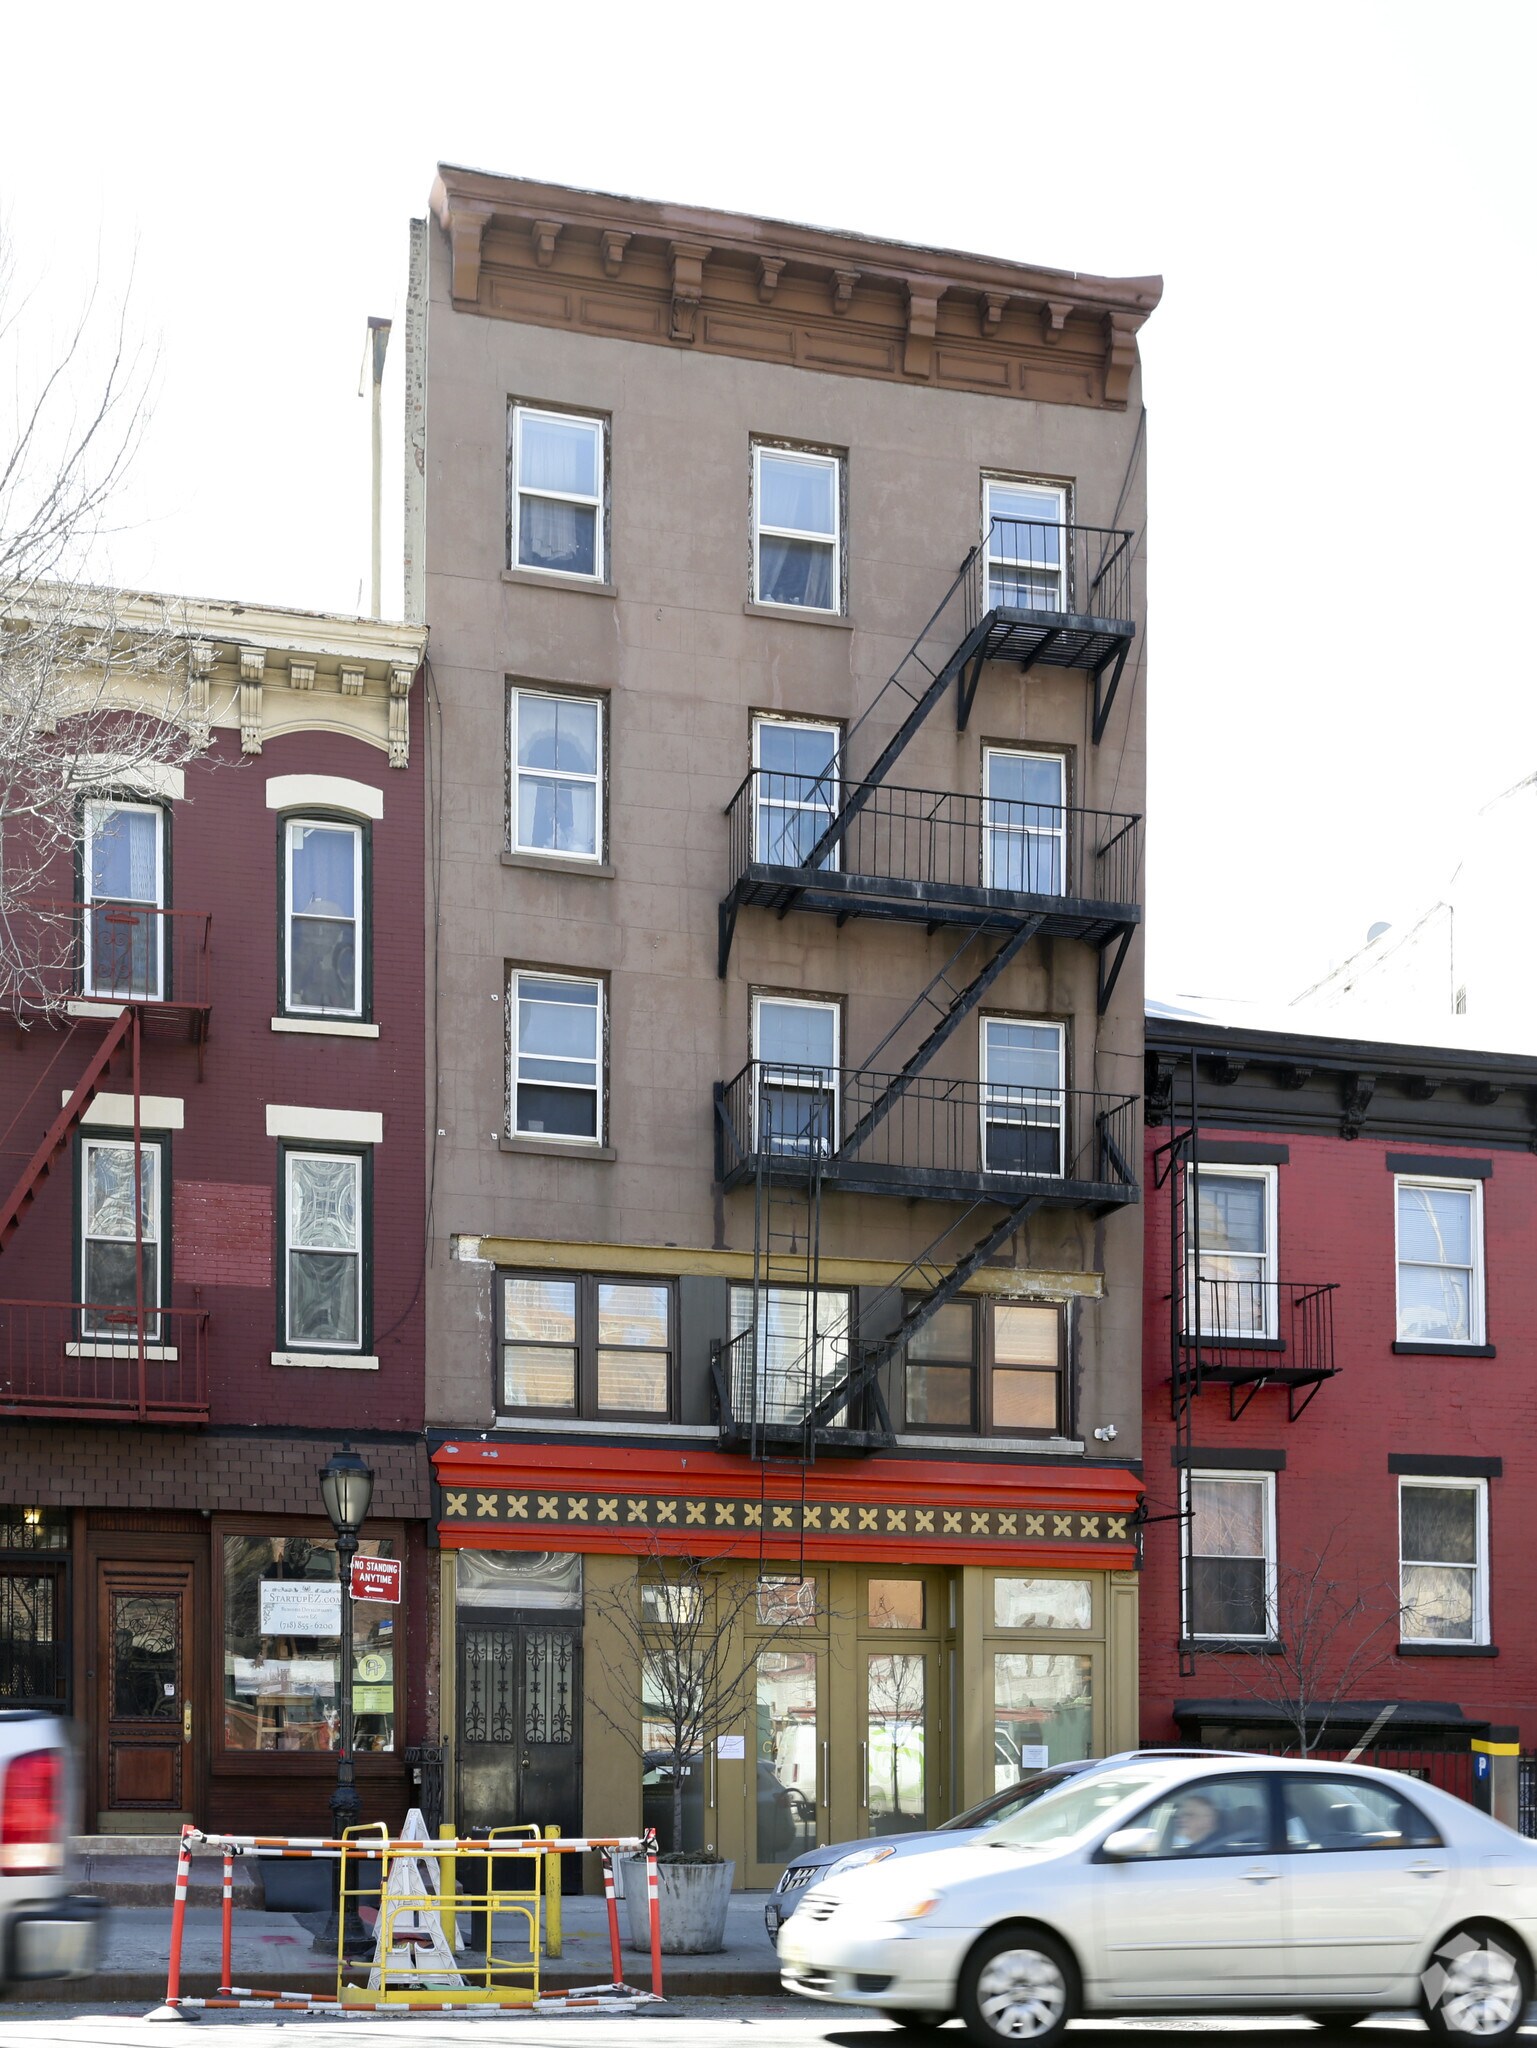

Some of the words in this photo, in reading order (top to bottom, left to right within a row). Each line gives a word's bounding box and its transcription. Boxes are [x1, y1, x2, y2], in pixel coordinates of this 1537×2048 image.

[354, 1560, 364, 1570] NO
[366, 1561, 398, 1574] STANDING
[359, 1572, 393, 1585] ANYTIME
[280, 1621, 296, 1630] (718)
[297, 1621, 309, 1631] 855
[314, 1622, 333, 1630] 6200
[1478, 1756, 1487, 1777] P
